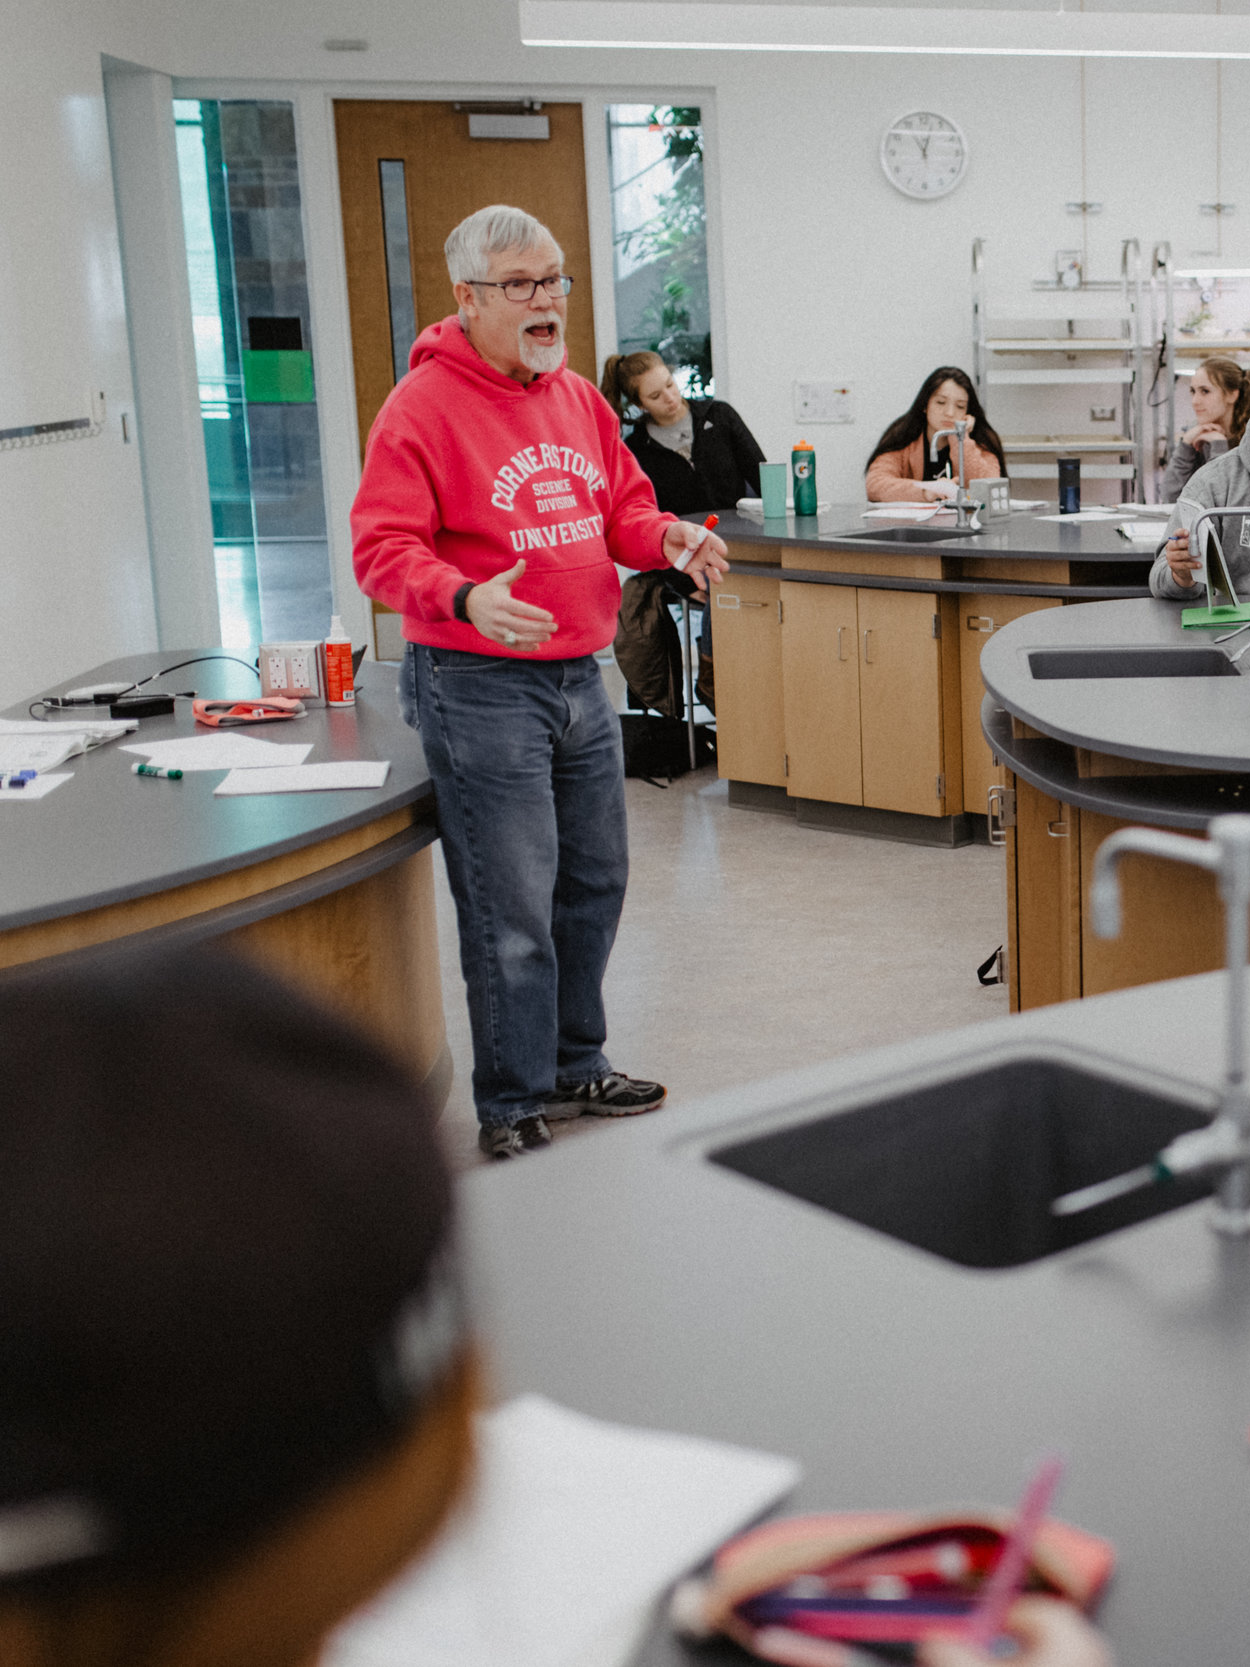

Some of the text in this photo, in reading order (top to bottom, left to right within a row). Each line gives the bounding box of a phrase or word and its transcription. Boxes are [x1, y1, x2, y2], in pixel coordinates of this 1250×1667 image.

[491, 443, 605, 511] CORNERSTONE
[532, 478, 572, 496] SCIENCE
[535, 494, 578, 513] DIVISION
